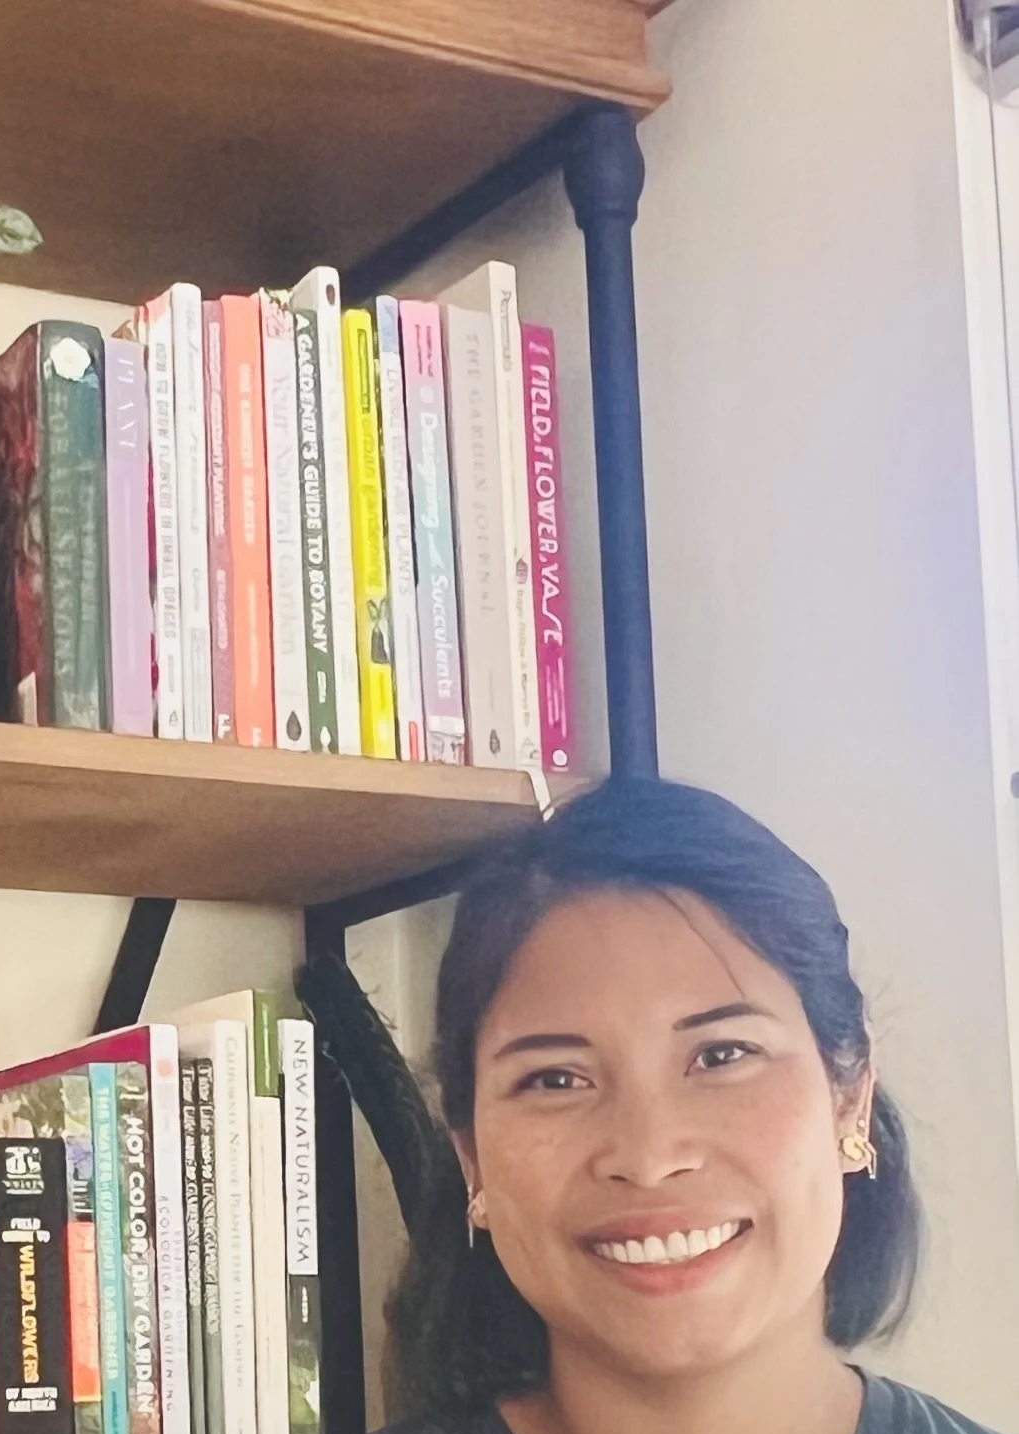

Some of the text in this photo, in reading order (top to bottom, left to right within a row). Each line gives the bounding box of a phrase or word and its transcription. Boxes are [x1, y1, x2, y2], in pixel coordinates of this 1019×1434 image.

[296, 314, 311, 330] A
[297, 333, 319, 461] GARDENER'S
[469, 389, 488, 492] GARDEN
[303, 465, 322, 529] GUIDE
[307, 535, 323, 564] TO
[396, 523, 412, 596] PLANTS
[417, 412, 441, 528] Designing
[431, 575, 454, 698] Succulents
[308, 569, 328, 654] BOTANY
[292, 1039, 311, 1263] NEW NATURALISM
[19, 1244, 40, 1384] WILDFLOWERS
[123, 1113, 156, 1413] HOT COLOR, DRY GARDEN
[103, 1285, 119, 1380] GARDENER
[163, 1309, 175, 1412] GARDENING
